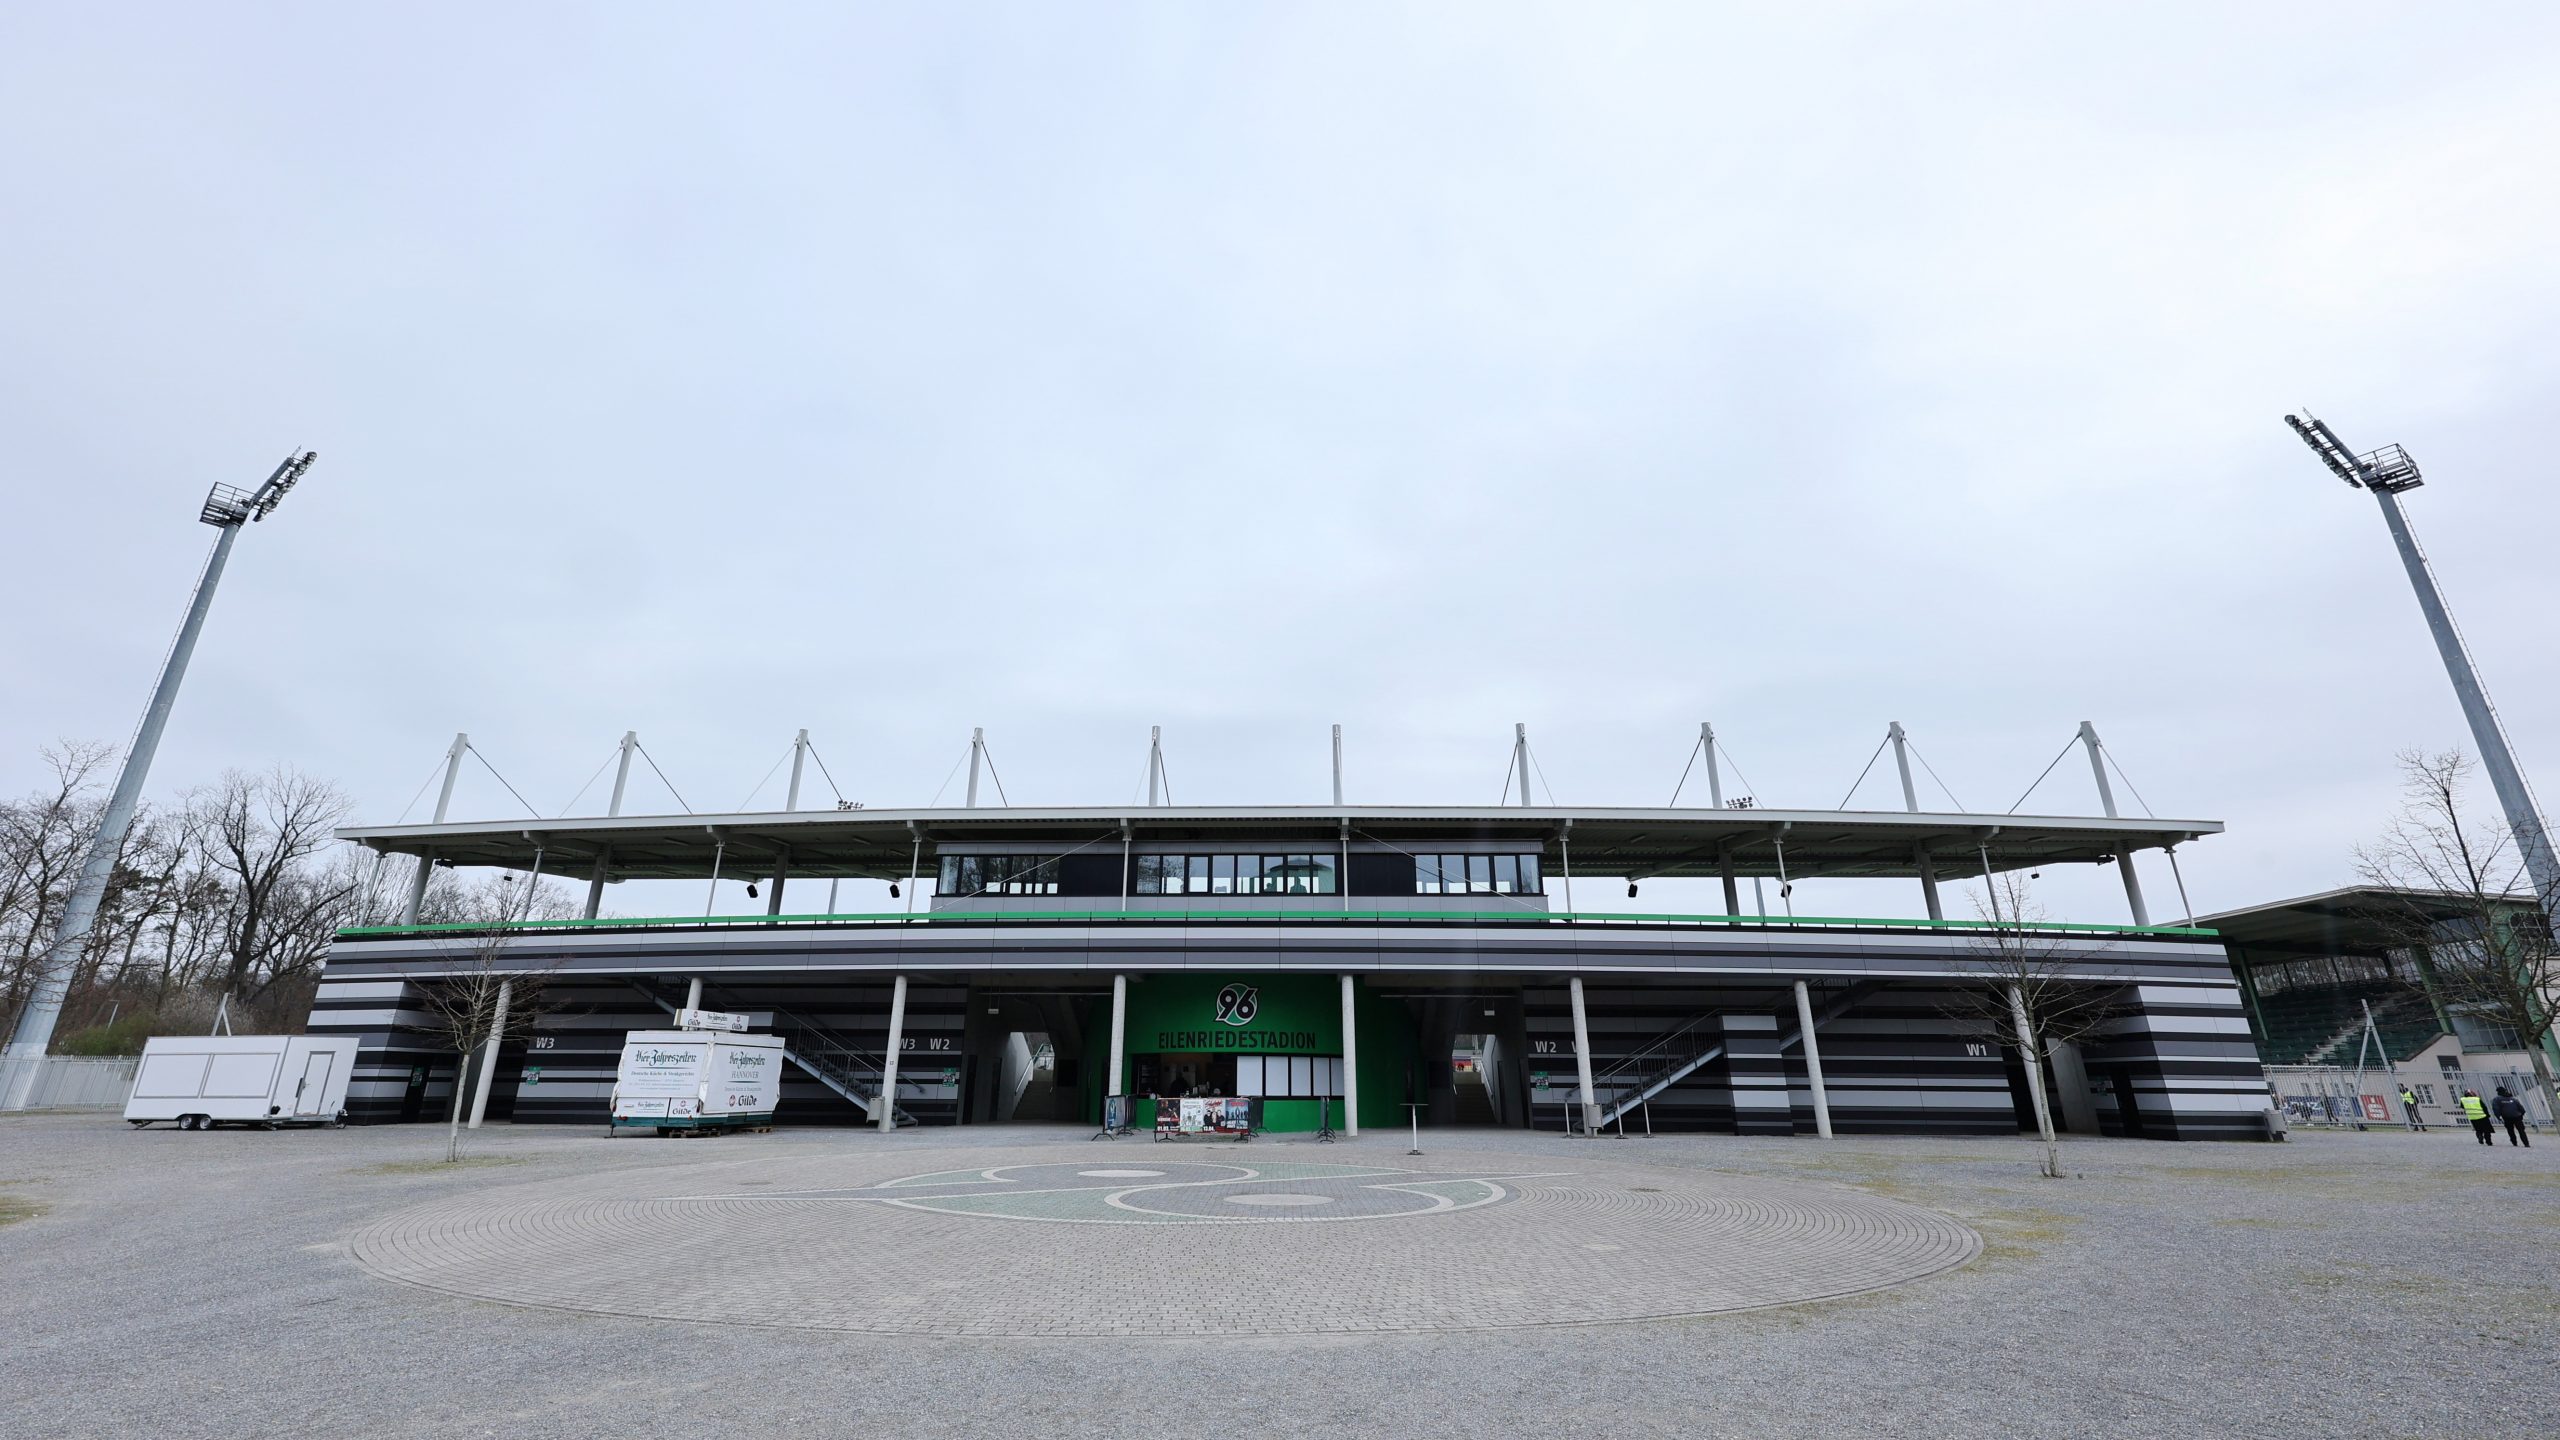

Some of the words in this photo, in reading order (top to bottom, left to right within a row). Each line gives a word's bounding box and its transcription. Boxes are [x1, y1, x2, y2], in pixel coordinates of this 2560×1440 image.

[1214, 986, 1259, 1023] 96
[535, 1037, 555, 1049] W3
[929, 1038, 950, 1050] W2
[1158, 1031, 1316, 1049] EILENRIEDESTADION
[1535, 1040, 1557, 1053] W2
[1965, 1043, 1988, 1057] W1
[738, 1094, 757, 1107] Gilde
